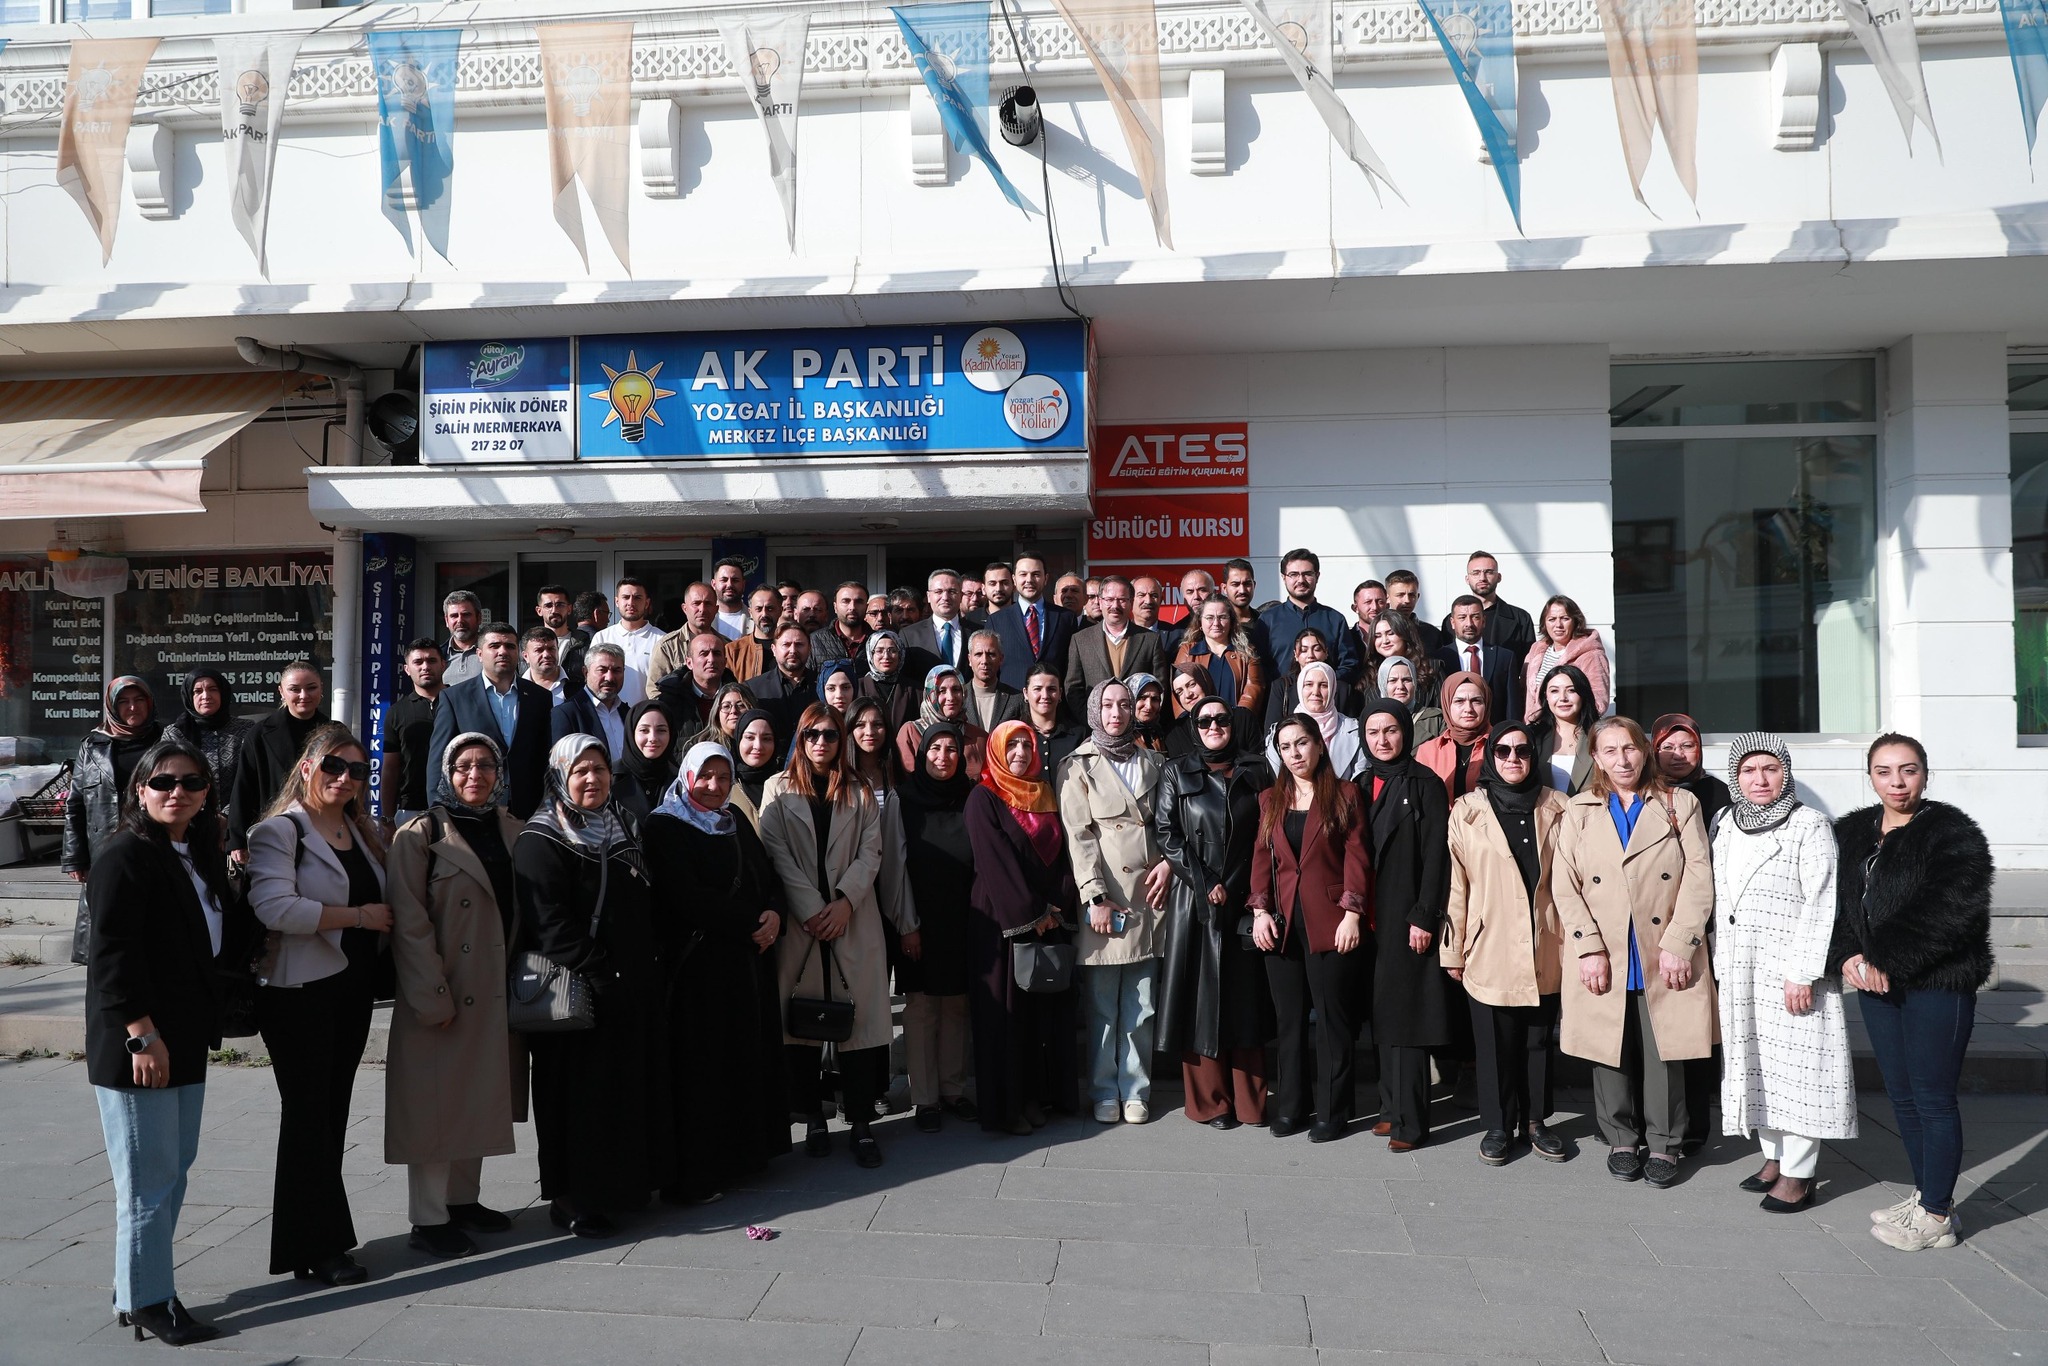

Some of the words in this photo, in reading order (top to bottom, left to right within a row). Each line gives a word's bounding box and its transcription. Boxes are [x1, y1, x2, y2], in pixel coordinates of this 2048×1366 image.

[224, 129, 238, 140] AK
[477, 352, 519, 378] Ayran
[691, 350, 769, 391] AK
[792, 334, 944, 389] PARTİ
[429, 399, 466, 418] ŞİRİN
[469, 398, 516, 414] PİKNİK
[519, 396, 568, 413] DÖNER
[691, 402, 781, 421] YOZGAT
[789, 397, 806, 419] İL
[813, 394, 945, 423] BAŞKANLIĞI
[1009, 400, 1047, 420] gençlik
[434, 420, 470, 434] SALİH
[473, 420, 563, 434] MERMERKAYA
[1021, 414, 1056, 429] kolları
[708, 428, 776, 445] MERKEZ
[783, 426, 815, 446] İLÇE
[822, 422, 928, 445] BAŞKANLIĞI
[471, 440, 490, 452] 217
[492, 440, 507, 451] 32
[509, 439, 524, 451] 07
[1119, 467, 1156, 478] SÜRÜCÜ
[1158, 466, 1189, 476] EĞİTİM
[1191, 466, 1245, 477] KURUMLARI
[1092, 515, 1172, 540] SÜRÜCÜ
[1179, 517, 1244, 538] KURSU
[132, 564, 219, 590] YENİCE
[45, 600, 70, 611] Kuru
[53, 618, 78, 628] Kuru
[80, 618, 101, 628] Erik
[370, 581, 382, 655] ŞİRİN
[52, 636, 77, 646] Kuru
[80, 636, 100, 646] Dud
[126, 633, 172, 646] Doğadan
[174, 632, 224, 643] Sofranıza
[225, 631, 249, 642] Yerli
[257, 630, 299, 643] Organik
[301, 632, 314, 641] ve
[72, 654, 101, 664] Ceviz
[158, 651, 226, 663] Ürünlerimizle
[228, 649, 310, 663] Hizmetinizdeyiz
[32, 672, 100, 684] Kompostuluk
[240, 671, 263, 685] 125
[32, 690, 57, 701] Kuru
[59, 690, 100, 700] Patlıcan
[233, 690, 275, 703] YENİCE
[45, 708, 70, 719] Kuru
[72, 708, 100, 718] Biber
[369, 661, 382, 752] PİKNİK
